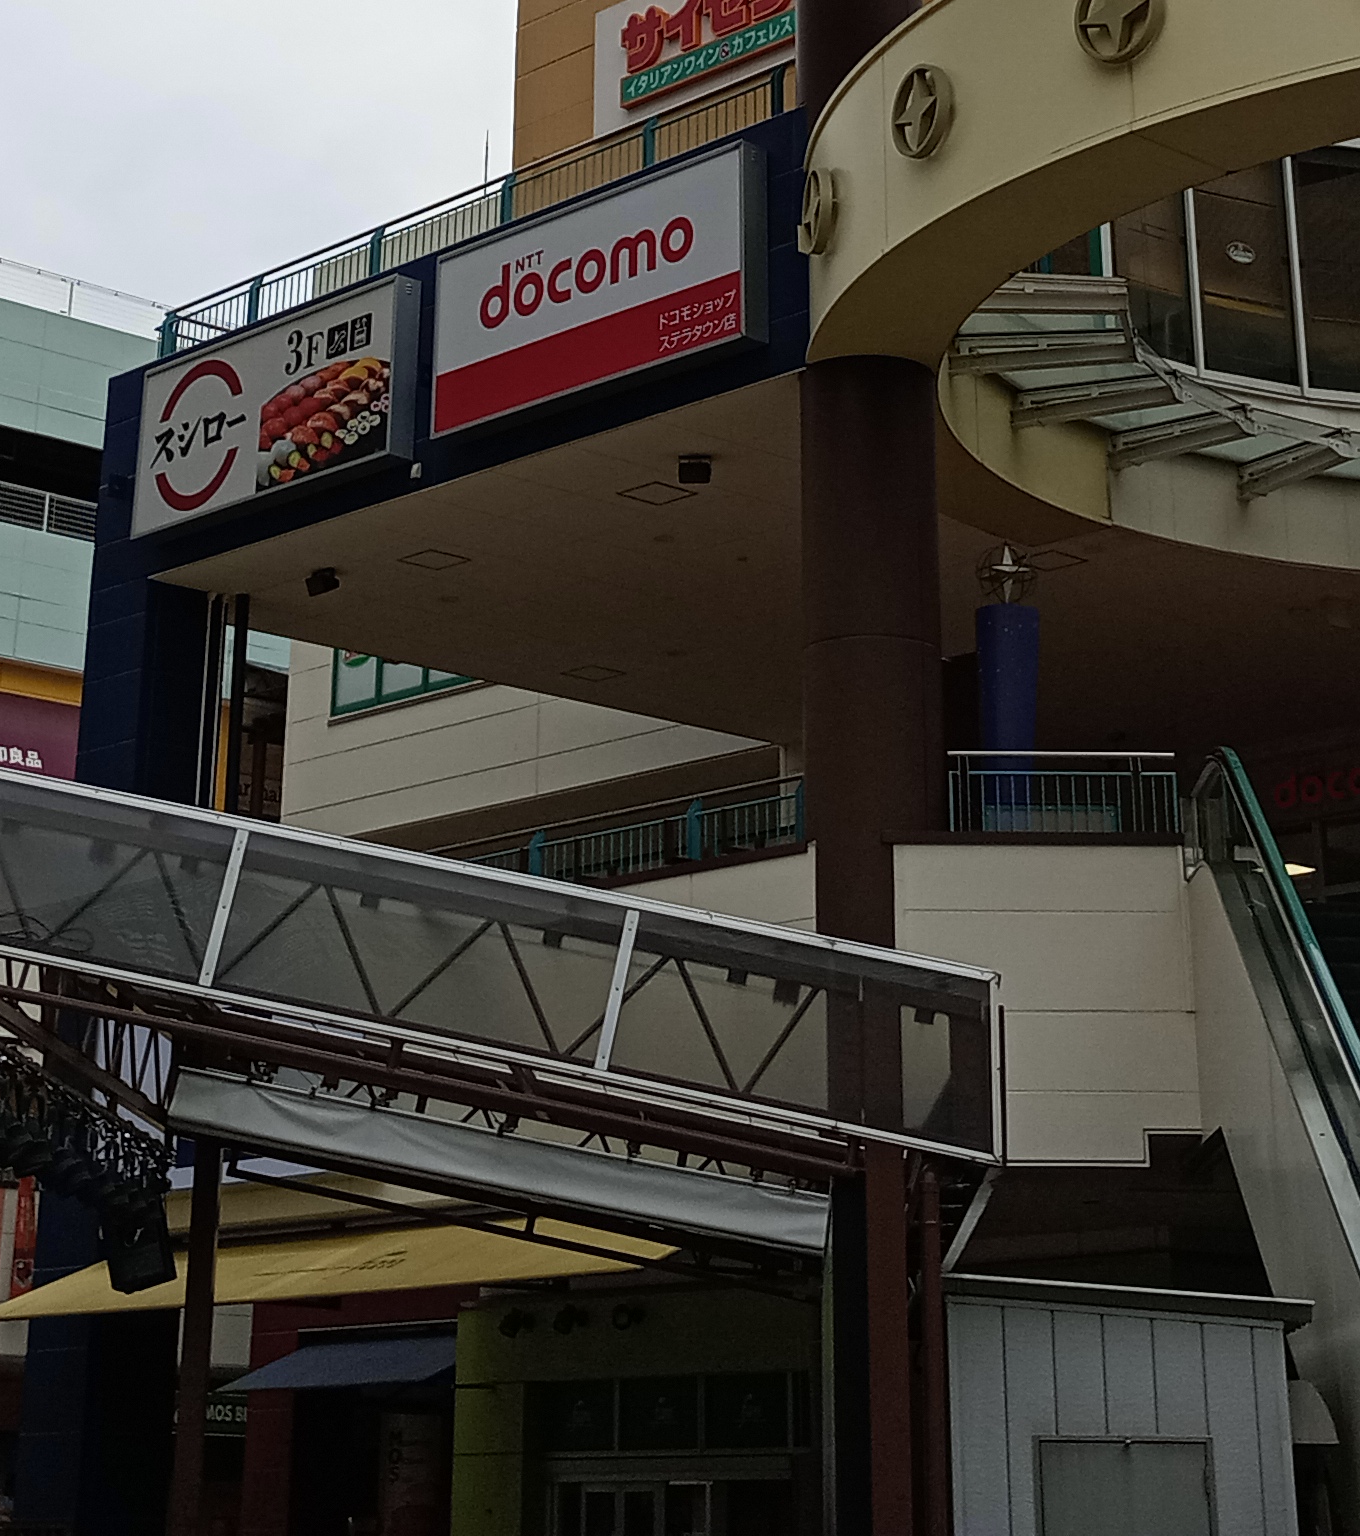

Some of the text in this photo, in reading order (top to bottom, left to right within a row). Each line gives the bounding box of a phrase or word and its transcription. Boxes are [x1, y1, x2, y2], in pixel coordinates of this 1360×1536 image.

[479, 216, 695, 330] docomo
[514, 250, 544, 273] NTT
[659, 288, 737, 331] ドコモショップ
[284, 329, 325, 376] 3F
[659, 312, 737, 353] ステラタウン店
[149, 410, 247, 470] スシロー
